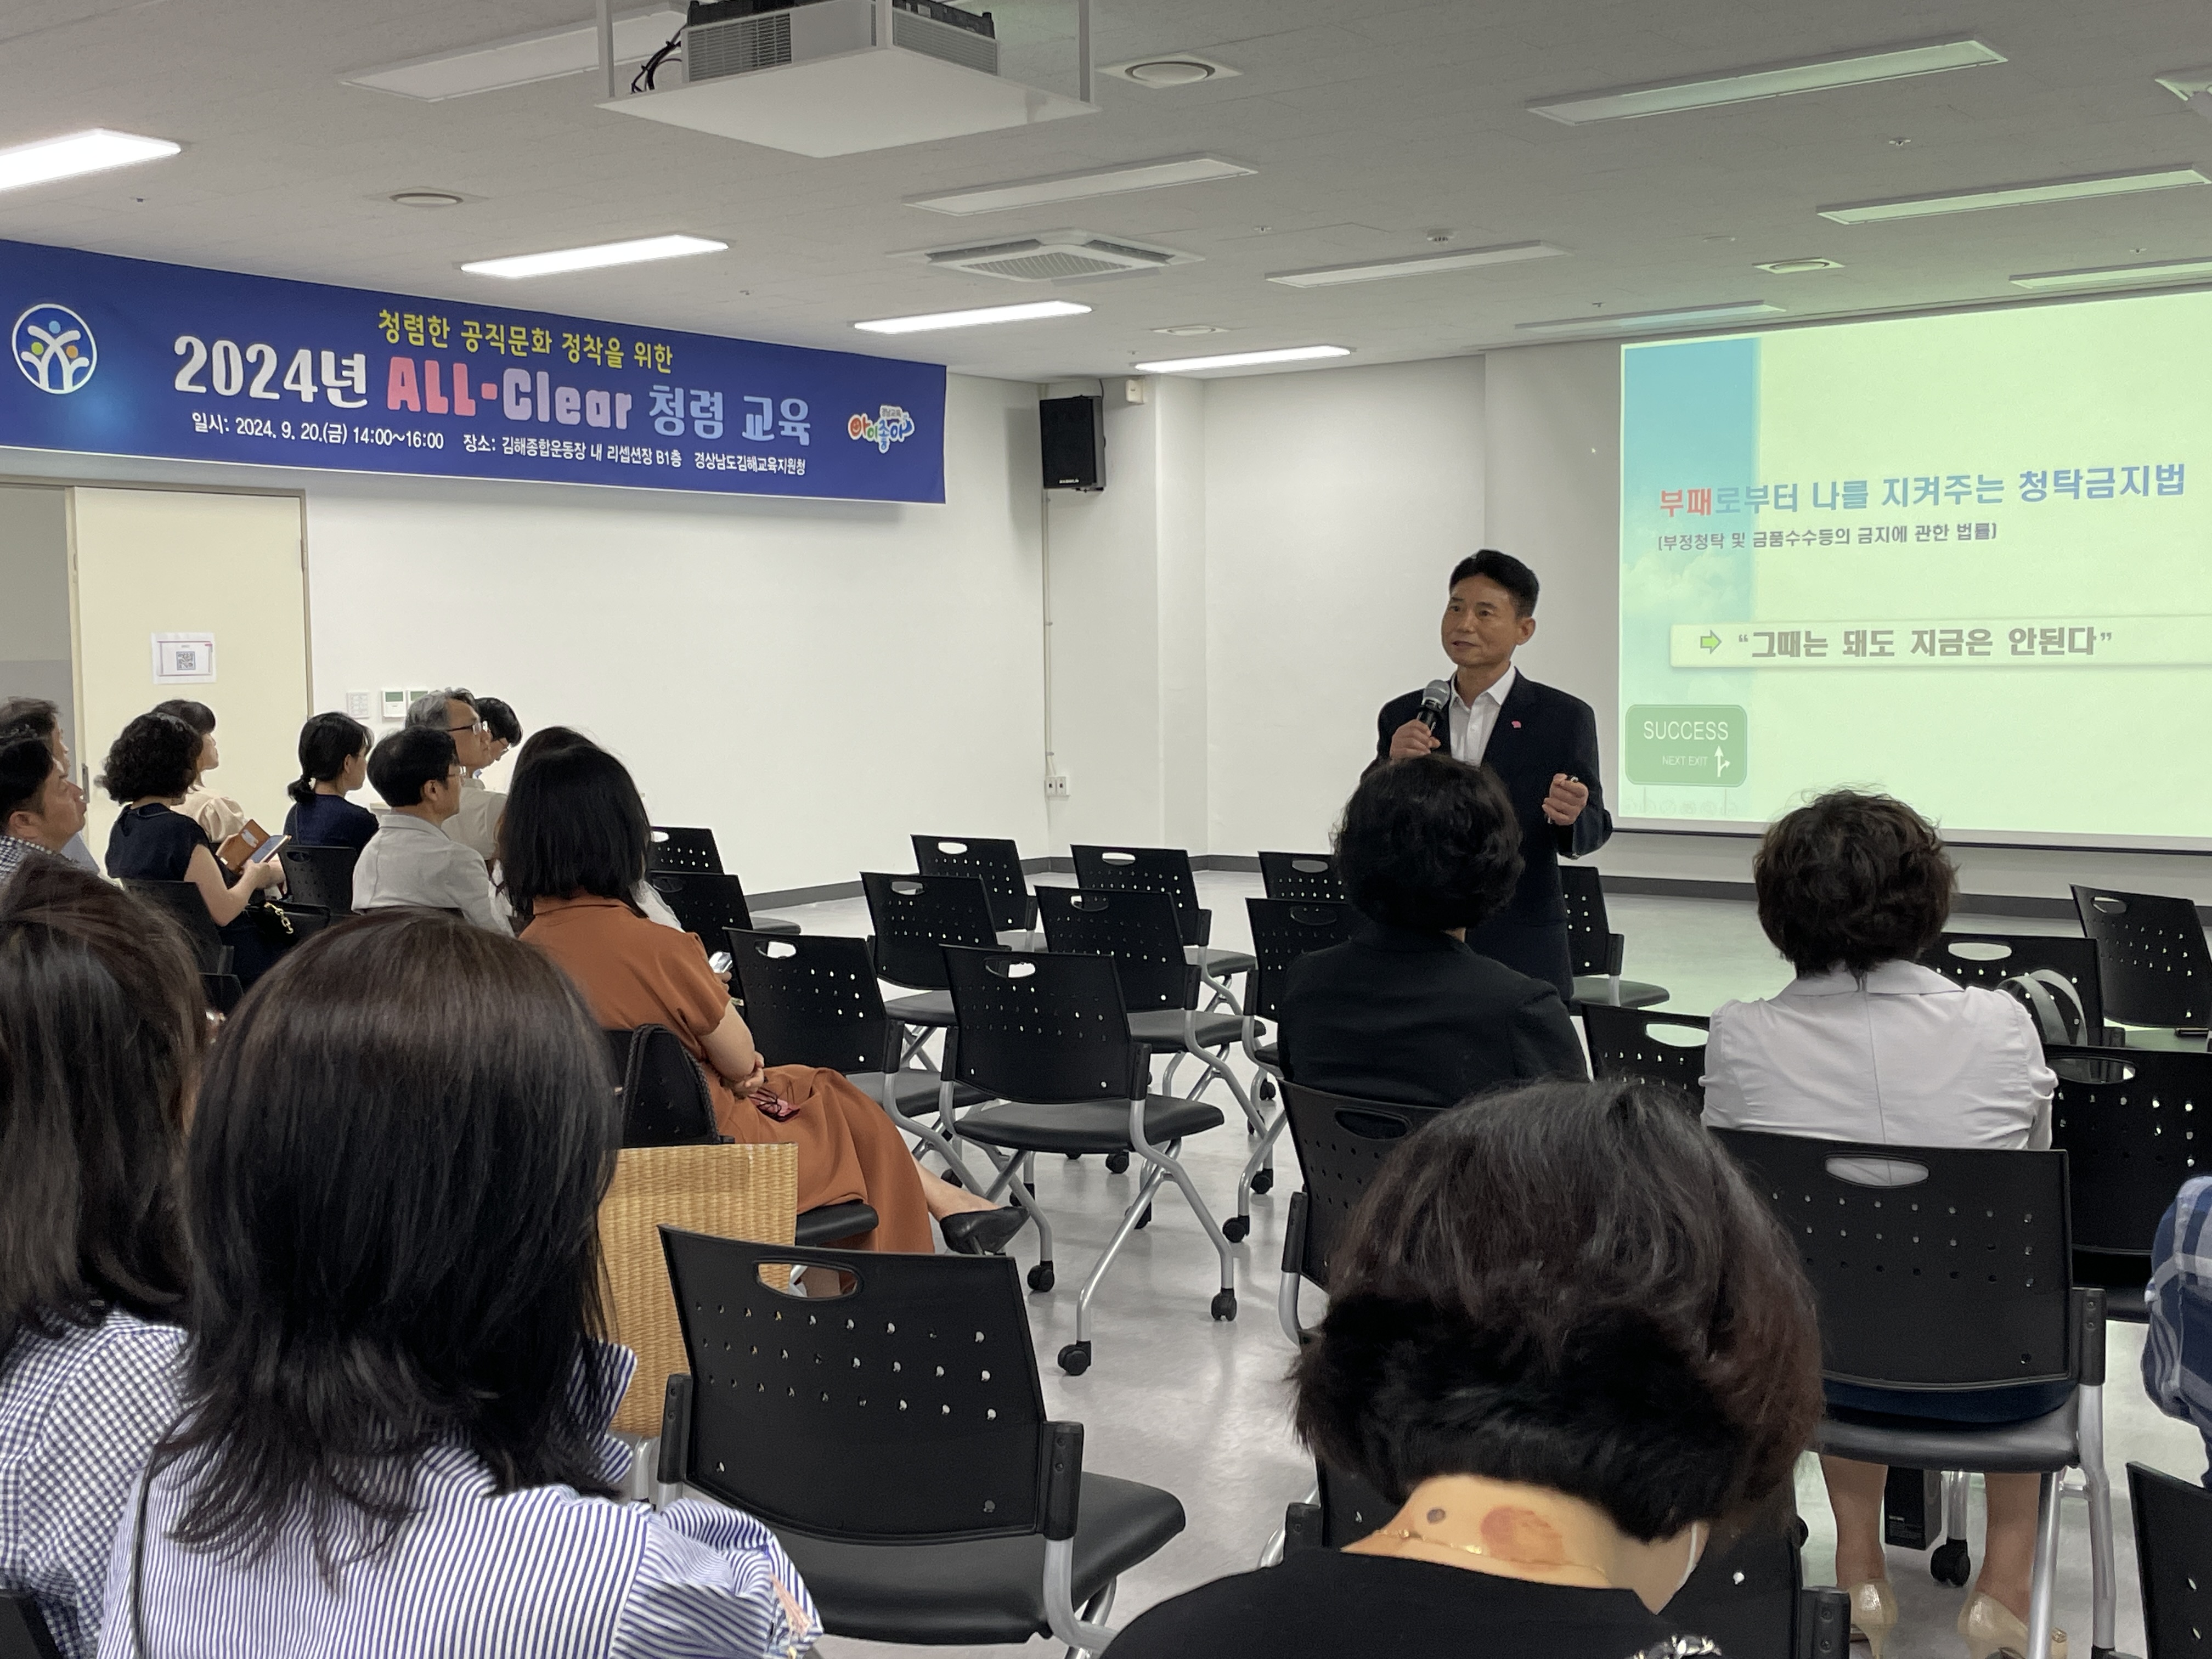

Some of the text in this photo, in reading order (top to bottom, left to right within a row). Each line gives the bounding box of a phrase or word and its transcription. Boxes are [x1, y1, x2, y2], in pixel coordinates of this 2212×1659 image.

[379, 309, 673, 374] 청렴한 공직문화 정착을 위한
[174, 336, 368, 408] 2024년
[649, 385, 723, 439] 청렴
[742, 396, 810, 445] 교육
[193, 413, 805, 476] 일시: 2024. 9. 20.(금) 14:00~16:00 장소: 김해종합운동장 내 리셉션장 B1층 경상남도김해교육지원청
[1660, 464, 2185, 517] 부패로부터 나를 지켜주는 청탁금지법
[1732, 532, 1745, 549] 및
[1753, 528, 1850, 548] 금품수수등의
[1858, 526, 1908, 544] 금지에
[1915, 524, 1949, 542] 관한
[1843, 630, 1894, 657] 돼도
[1910, 629, 1993, 656] 지금은
[1644, 721, 1728, 740] SUCCESS
[1662, 755, 1708, 766] NEXT EXIT
